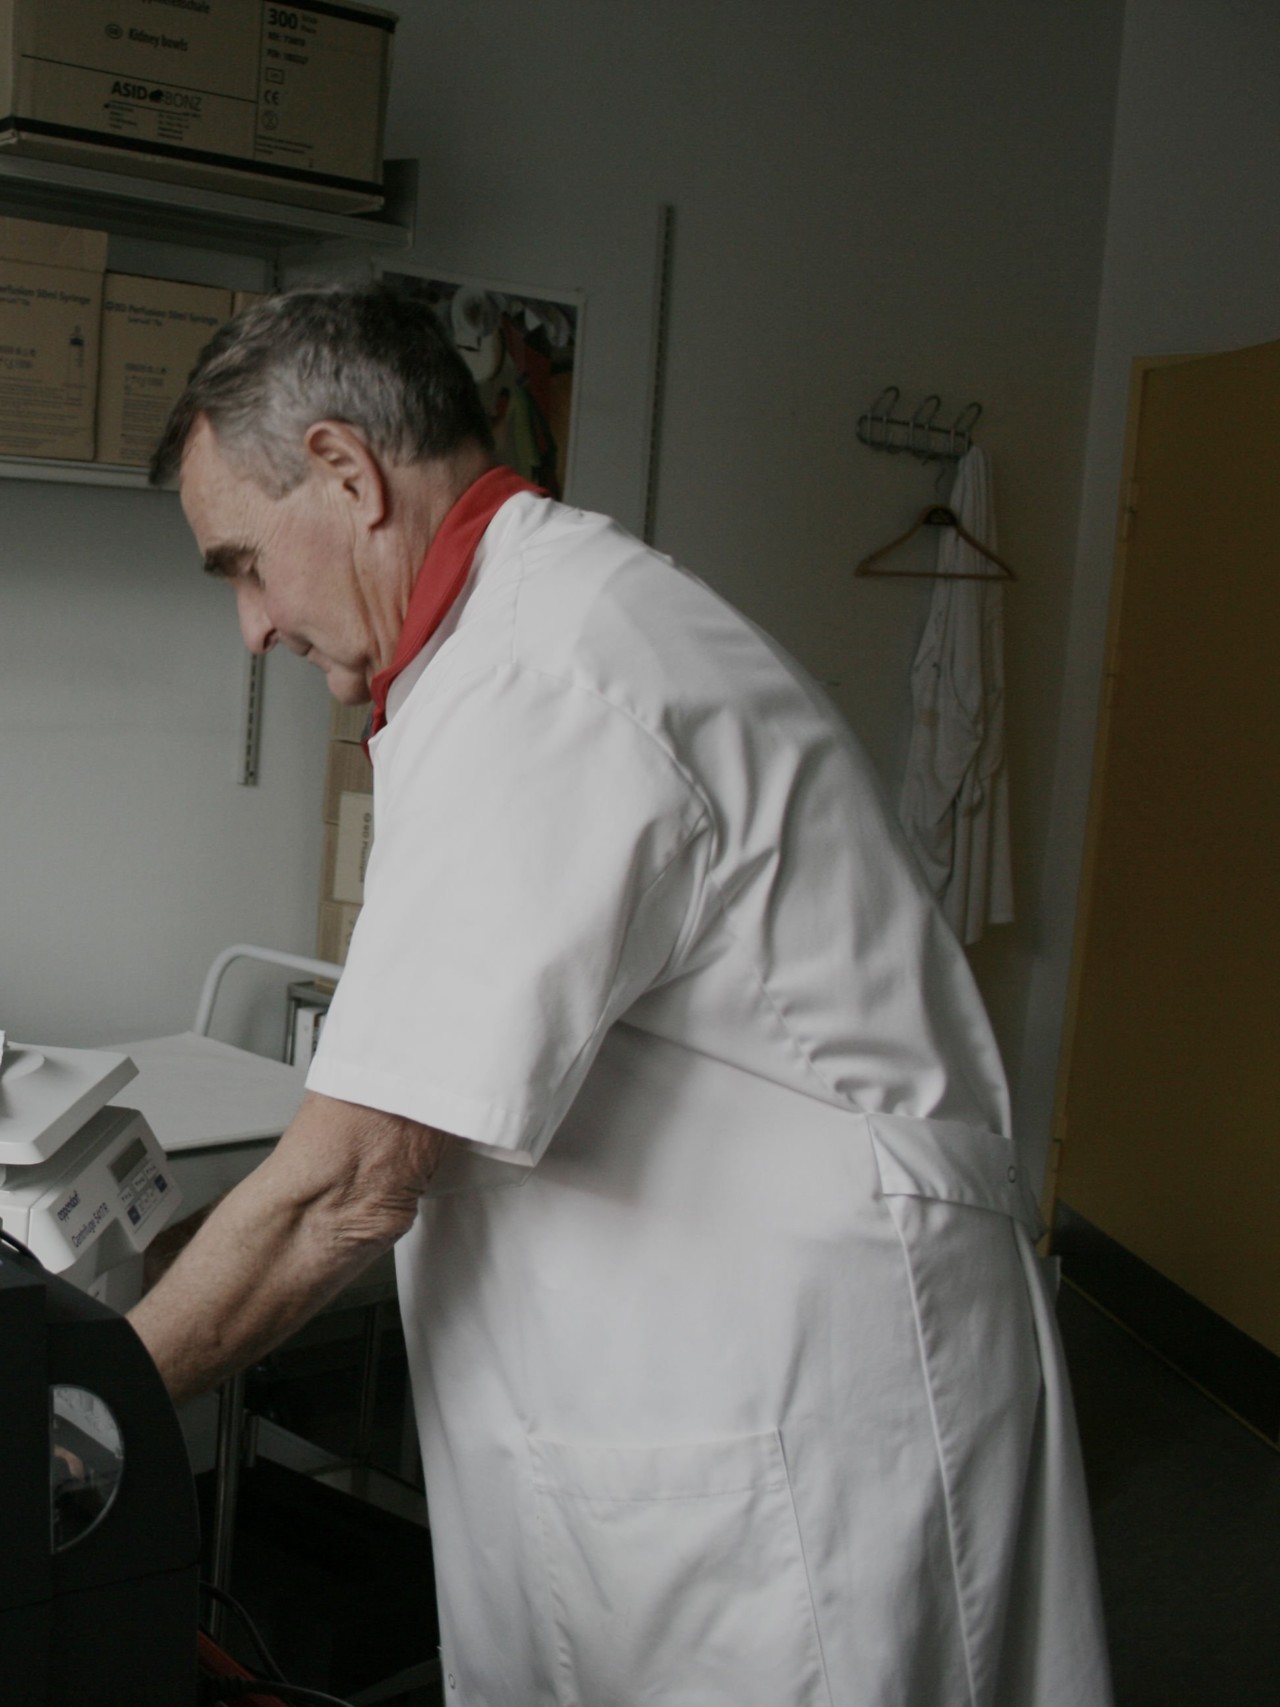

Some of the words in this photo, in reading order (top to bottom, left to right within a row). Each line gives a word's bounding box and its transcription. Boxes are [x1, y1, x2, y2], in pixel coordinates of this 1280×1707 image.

[268, 8, 298, 30] 300
[111, 80, 148, 100] ASID
[164, 90, 202, 112] BONZ
